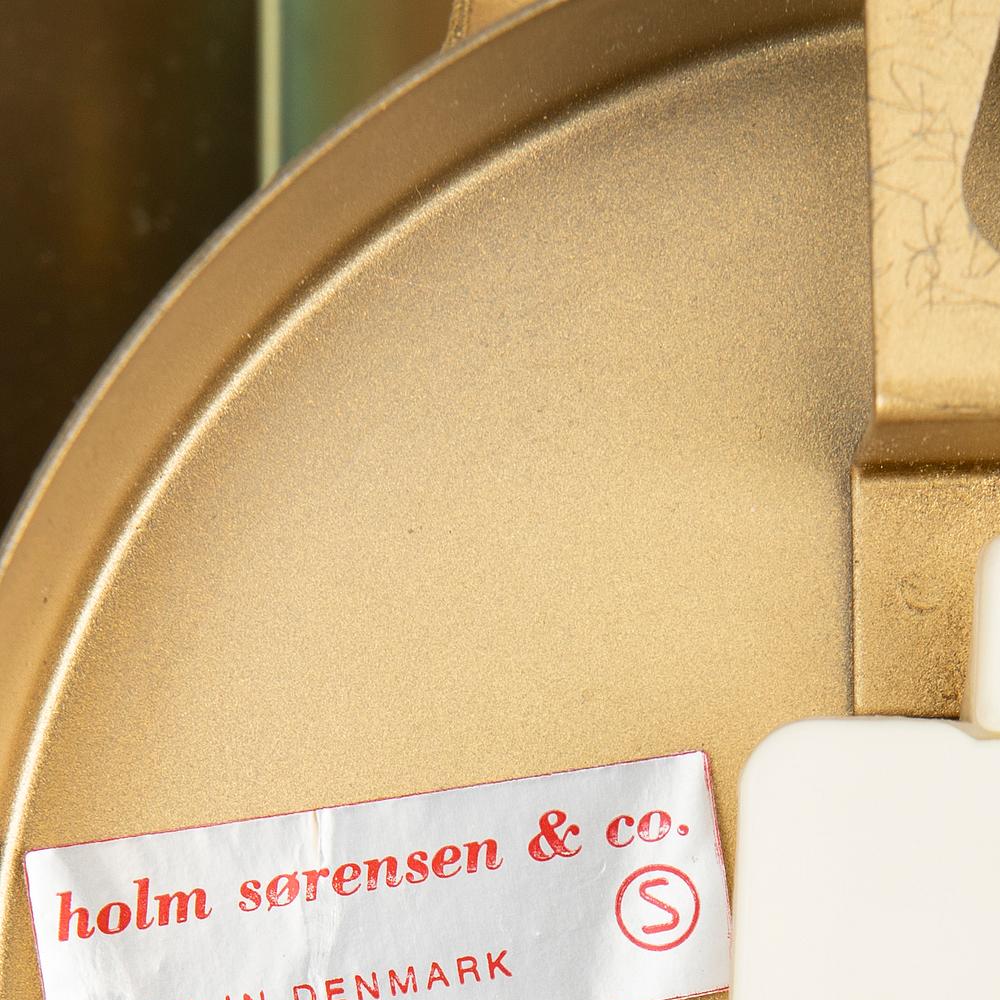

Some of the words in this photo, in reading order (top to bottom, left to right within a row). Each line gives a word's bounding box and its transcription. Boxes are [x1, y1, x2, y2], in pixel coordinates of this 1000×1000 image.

[58, 877, 212, 942] holm
[239, 837, 503, 911] sørensen
[528, 809, 584, 862] &
[606, 809, 690, 849] co.
